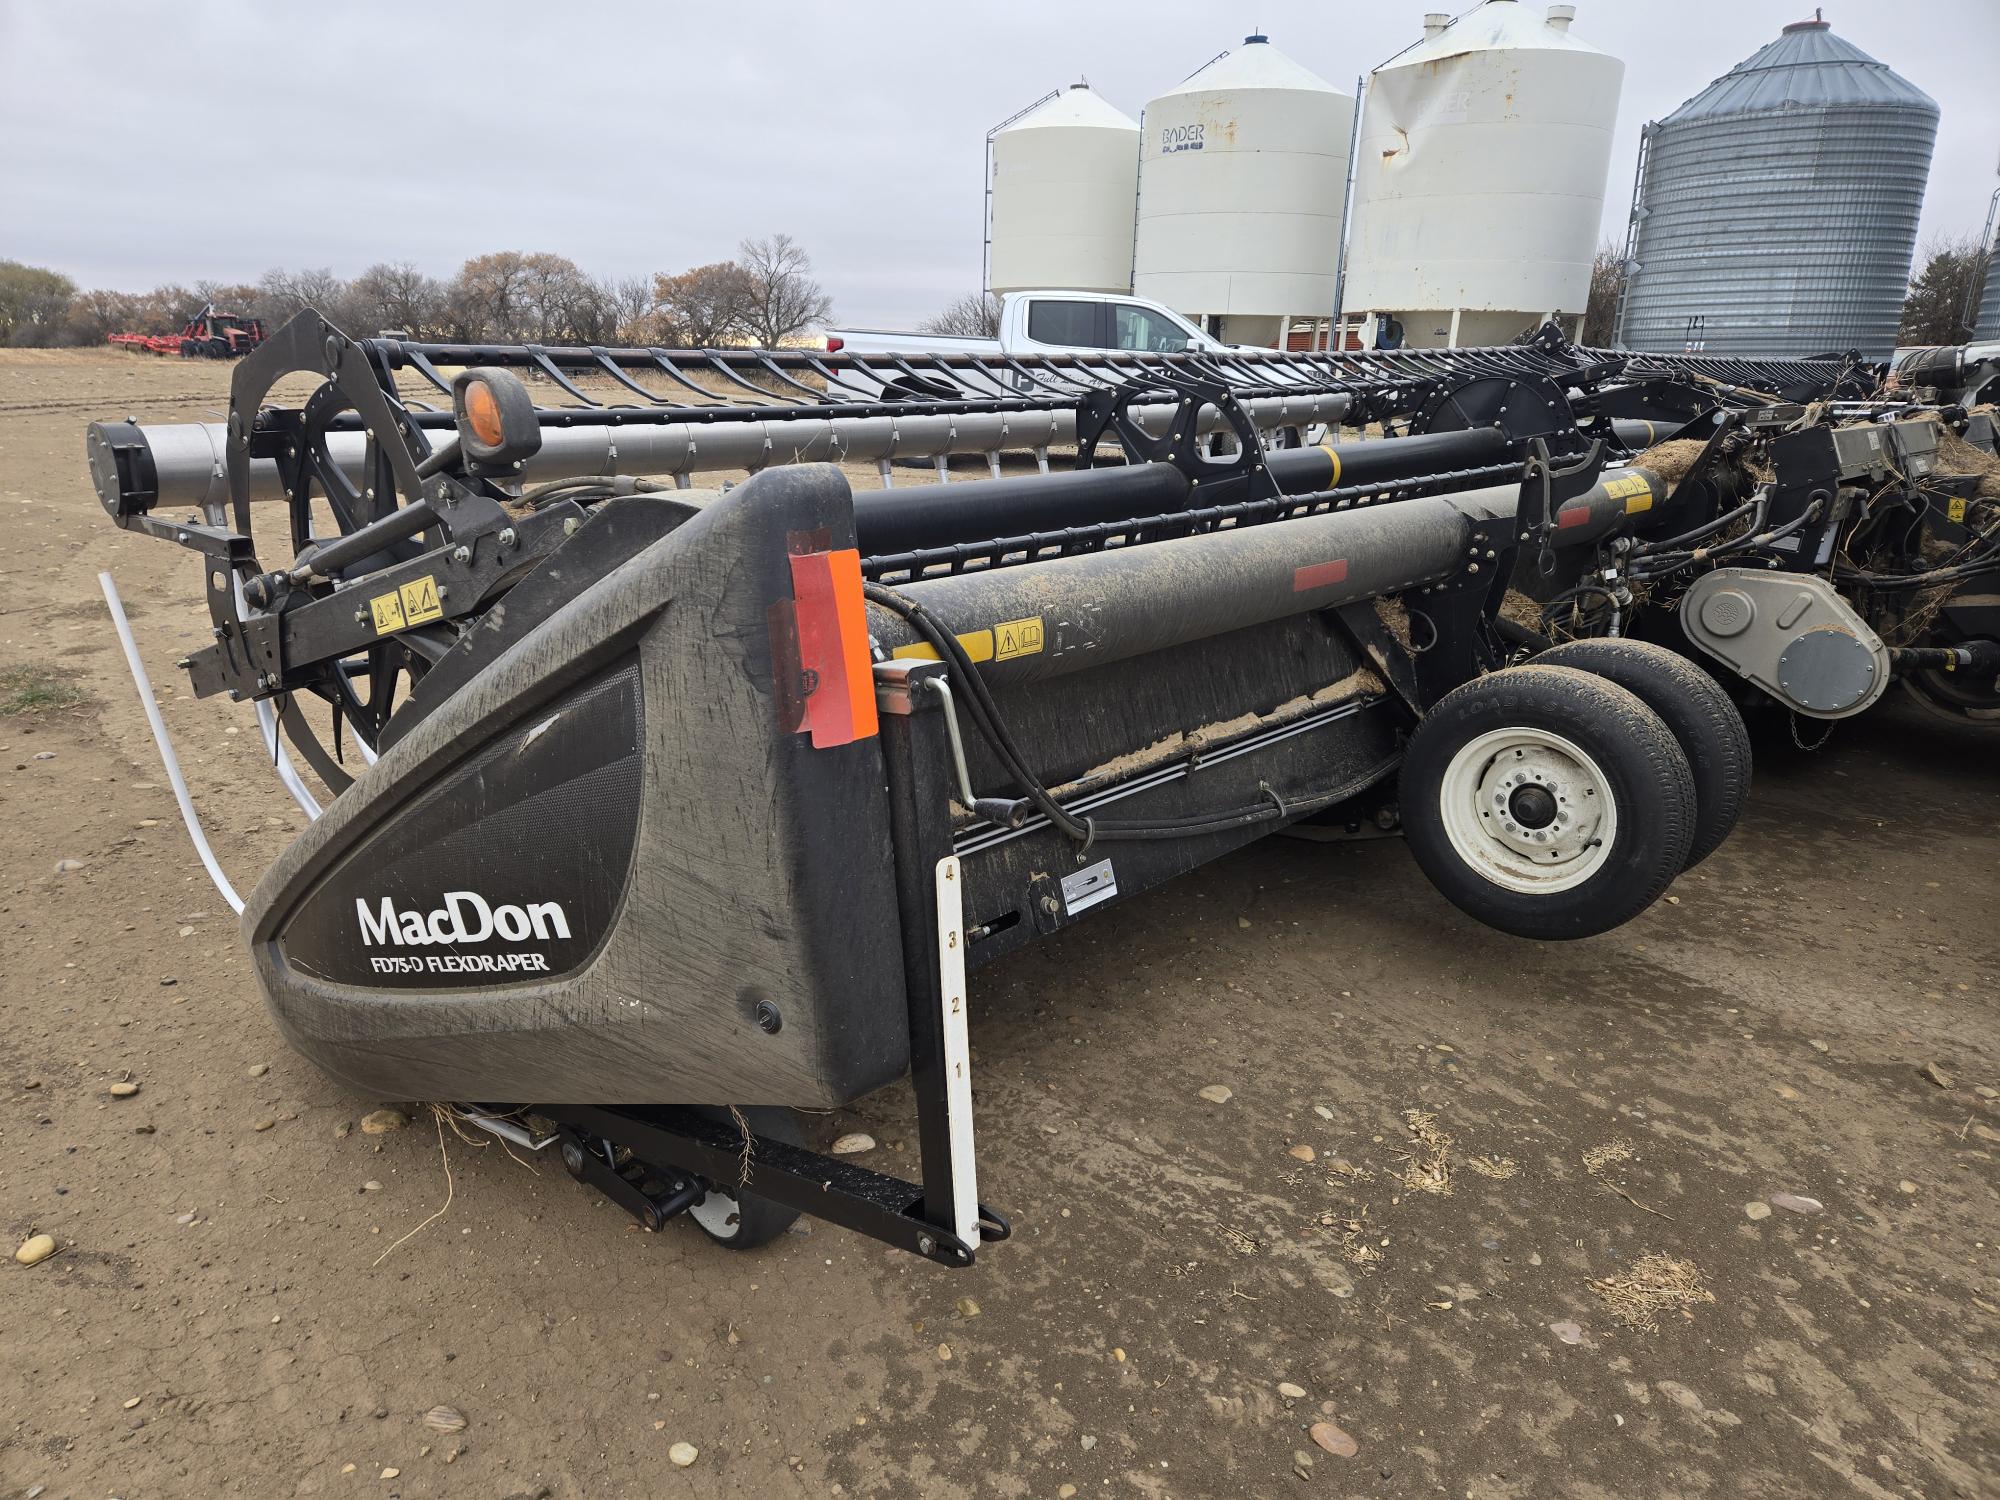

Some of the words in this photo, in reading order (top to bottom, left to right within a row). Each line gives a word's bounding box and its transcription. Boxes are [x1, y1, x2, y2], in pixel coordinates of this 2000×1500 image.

[1162, 124, 1205, 144] BADER
[1686, 315, 1705, 342] 14
[945, 864, 954, 881] 4
[355, 891, 572, 946] MacDon
[948, 930, 957, 949] 3
[370, 956, 424, 974] FD75-D
[425, 953, 551, 973] FLEXDRAPER
[951, 996, 960, 1014] 2
[955, 1062, 962, 1079] 1
